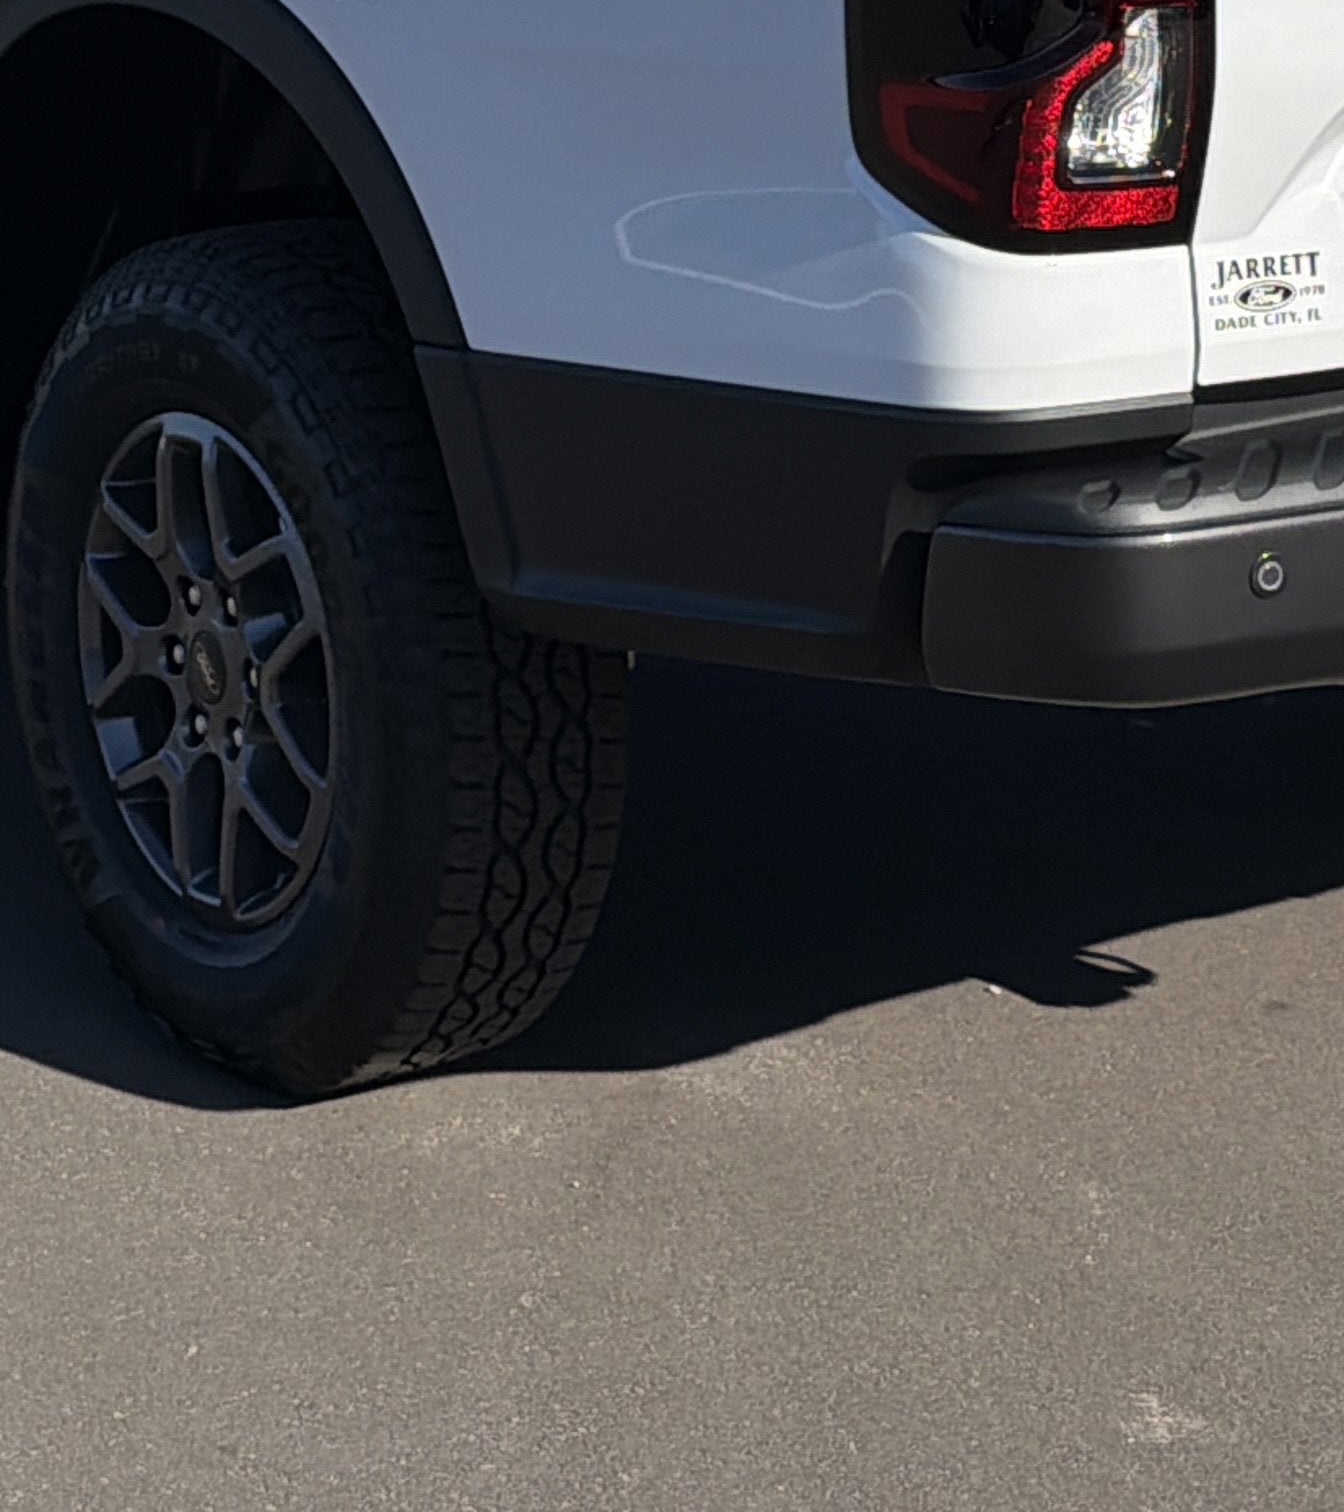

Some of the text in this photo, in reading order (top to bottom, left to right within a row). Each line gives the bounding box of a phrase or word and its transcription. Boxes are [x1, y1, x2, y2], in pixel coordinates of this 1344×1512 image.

[1210, 251, 1320, 290] JARRETT
[1215, 315, 1257, 331] DADE
[1263, 311, 1302, 326] CITY,
